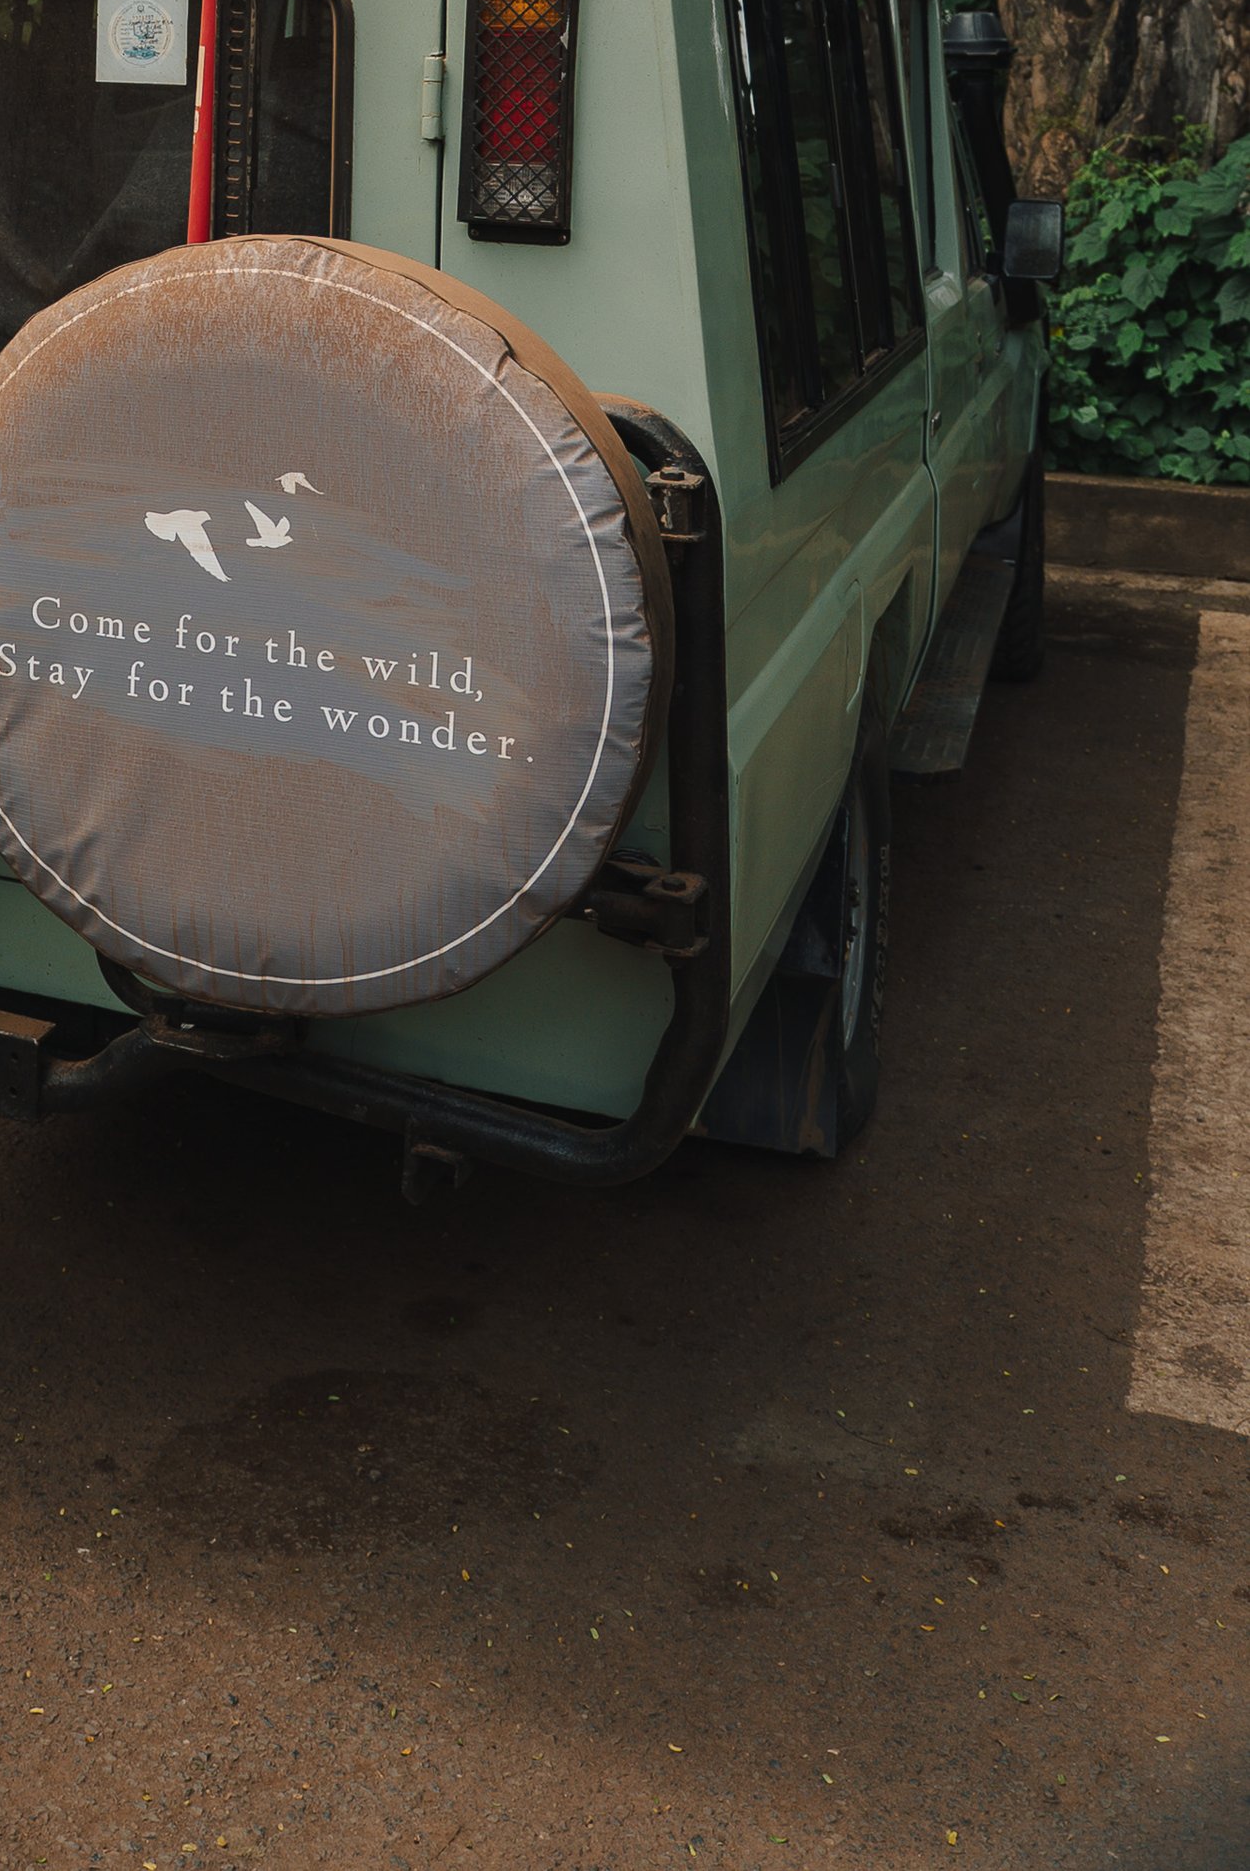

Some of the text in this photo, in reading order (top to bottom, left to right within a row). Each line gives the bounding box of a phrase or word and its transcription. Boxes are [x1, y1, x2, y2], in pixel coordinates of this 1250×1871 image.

[30, 595, 485, 702] Come for the wild,
[126, 660, 194, 707] for
[219, 678, 293, 723] the
[320, 706, 535, 763] wonder.
